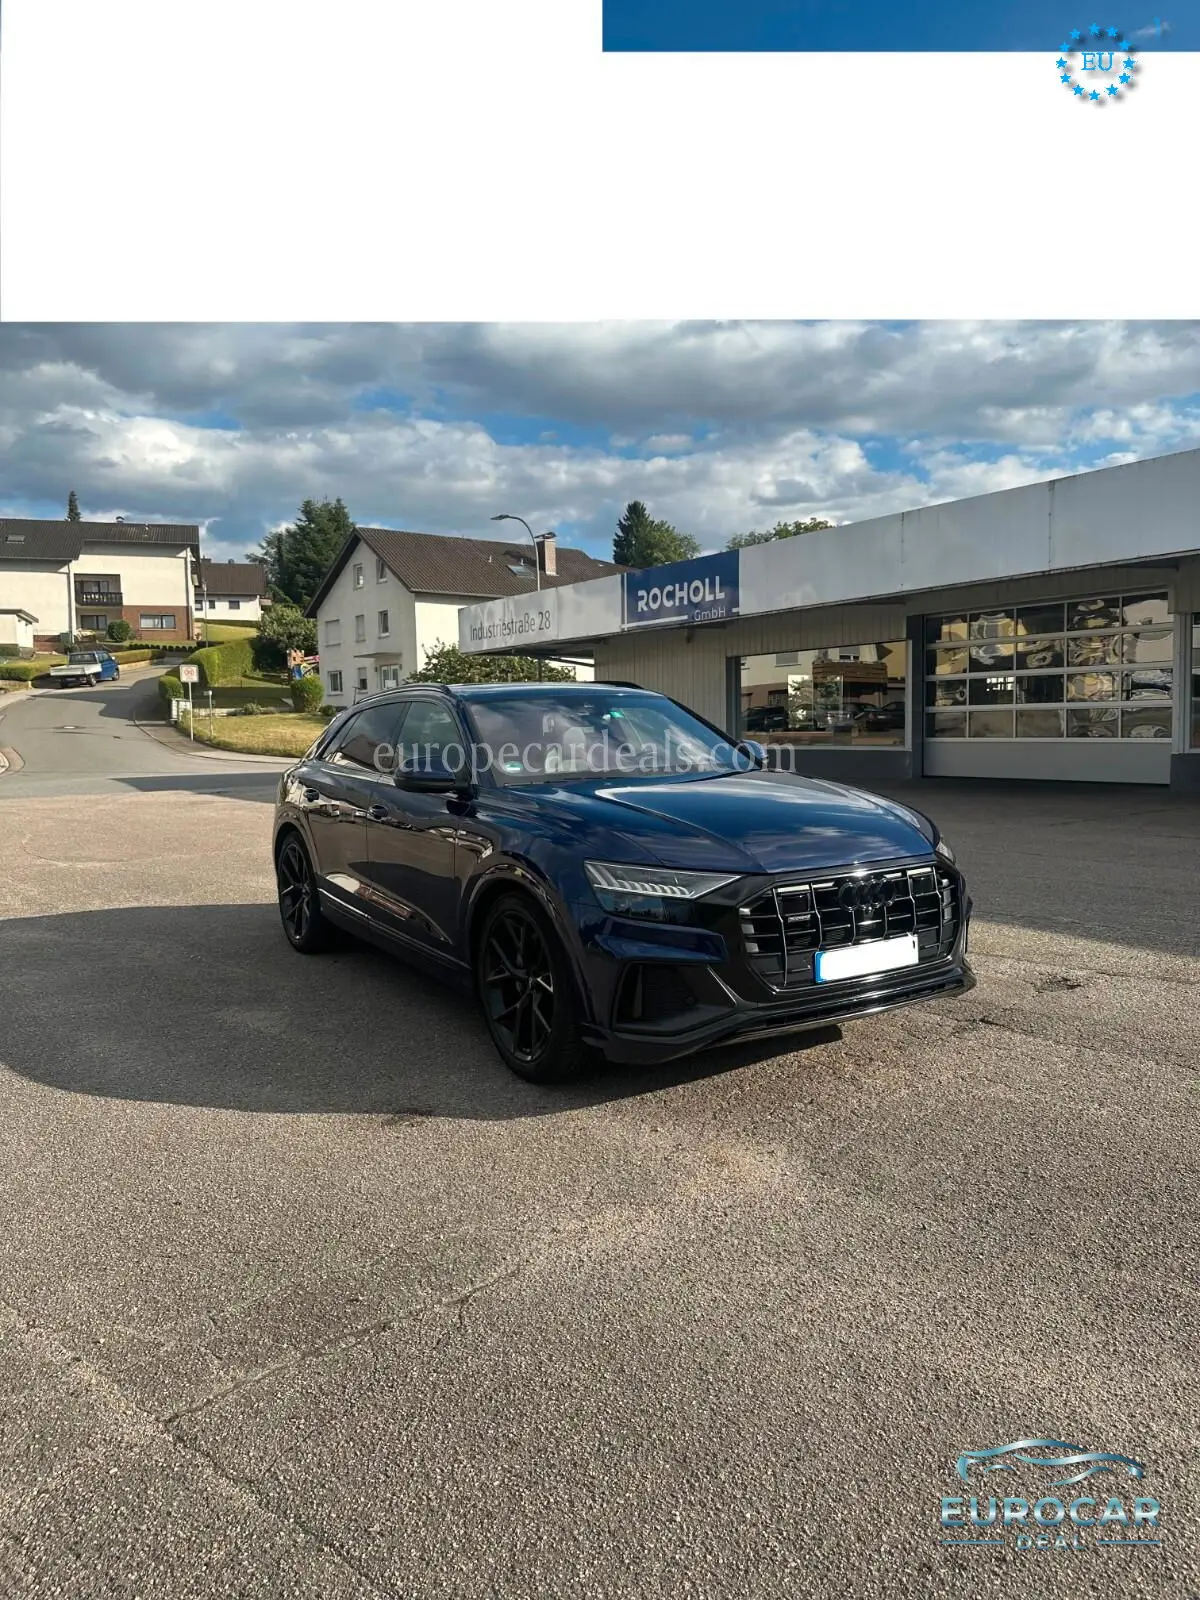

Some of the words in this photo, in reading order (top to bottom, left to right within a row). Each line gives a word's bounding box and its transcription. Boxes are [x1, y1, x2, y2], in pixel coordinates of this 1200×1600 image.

[637, 575, 726, 612] ROCHOLL
[470, 612, 536, 641] Industriestraße
[538, 609, 552, 631] 28
[693, 606, 727, 621] GmbH
